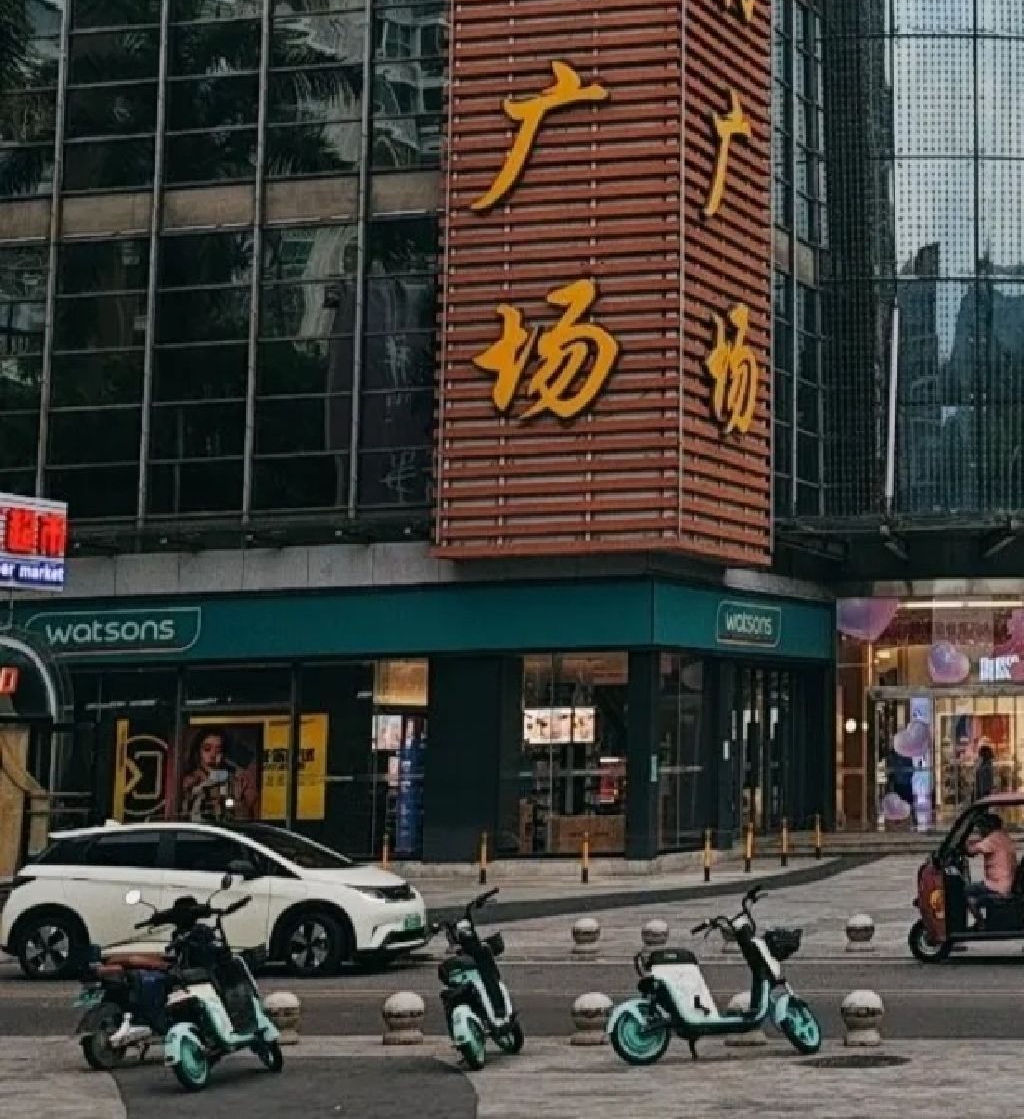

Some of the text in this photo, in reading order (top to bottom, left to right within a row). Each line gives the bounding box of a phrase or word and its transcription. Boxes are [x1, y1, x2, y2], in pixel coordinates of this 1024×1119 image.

[19, 564, 64, 582] market
[45, 619, 175, 645] watsons
[726, 611, 773, 635] watsons
